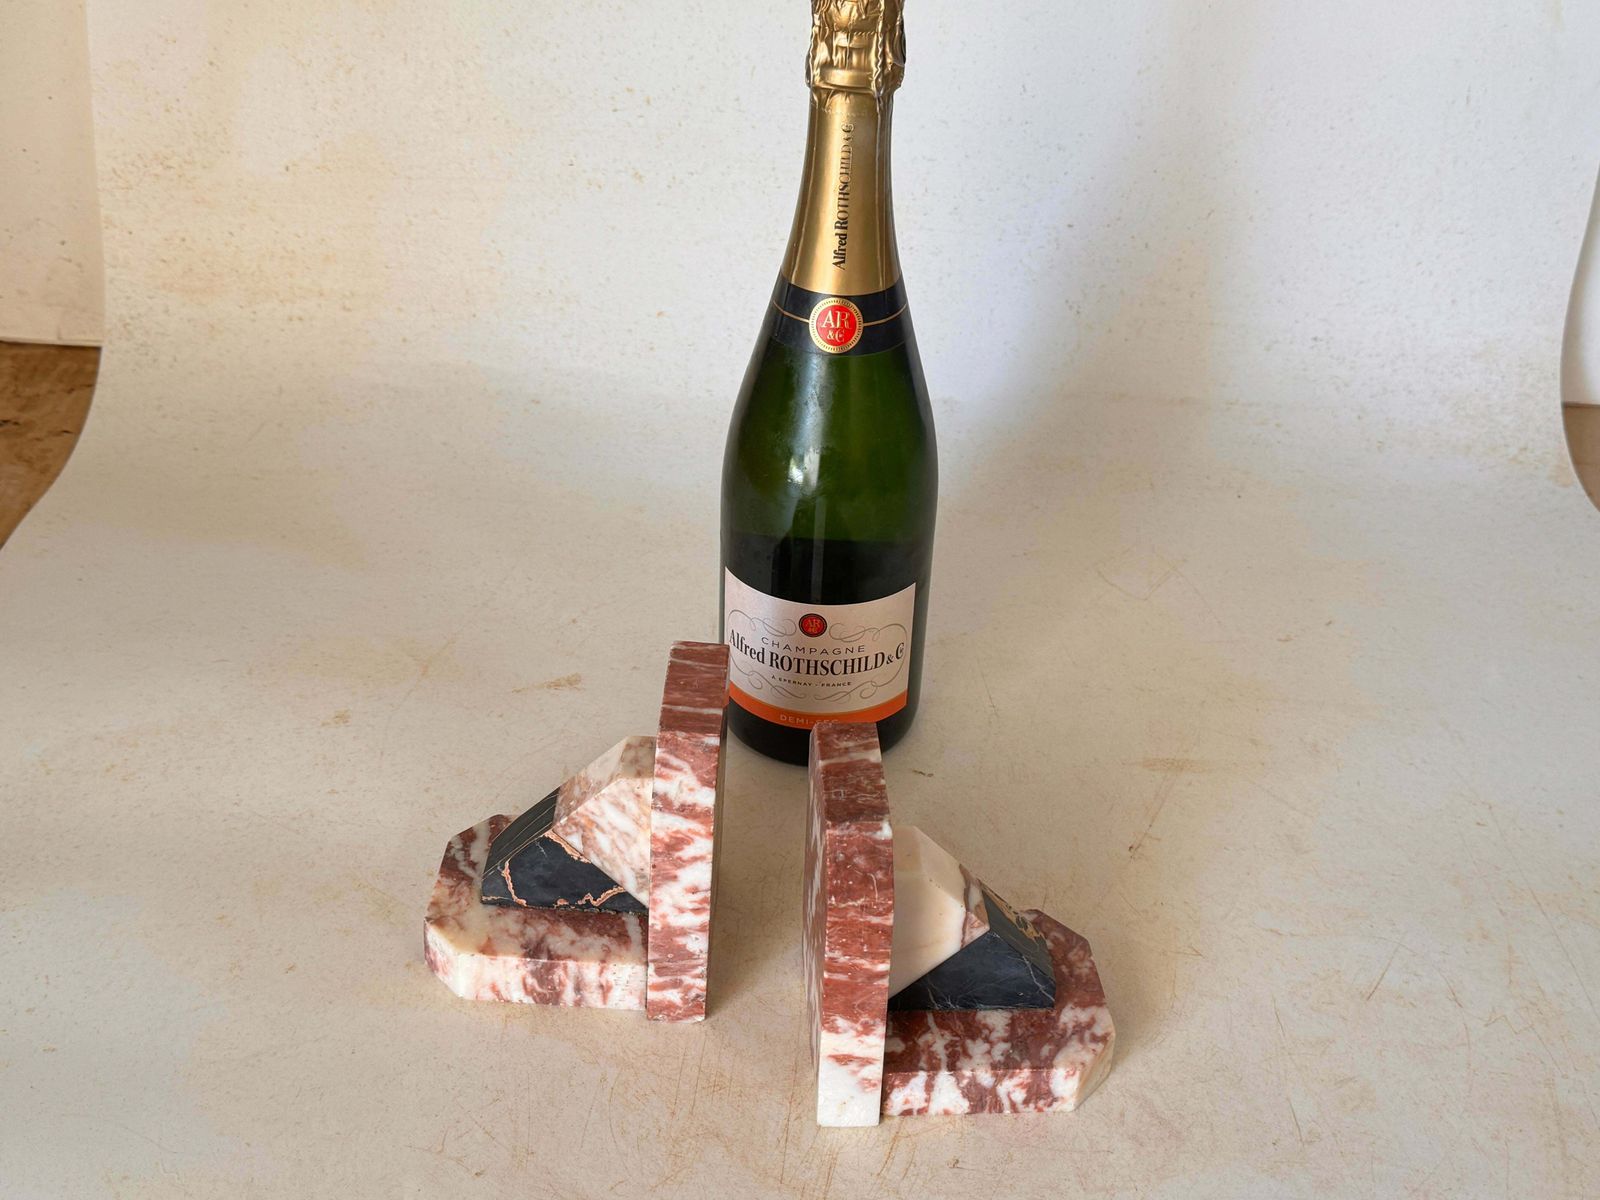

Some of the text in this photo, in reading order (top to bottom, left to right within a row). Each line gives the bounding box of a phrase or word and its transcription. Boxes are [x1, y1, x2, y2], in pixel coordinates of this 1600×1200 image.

[835, 144, 852, 231] ROTHSCHILD
[832, 233, 848, 270] Alfred
[821, 310, 852, 329] AR
[729, 629, 765, 665] Alfred
[769, 651, 886, 676] ROTHSCHILD
[761, 636, 866, 656] CHAMPAGNE
